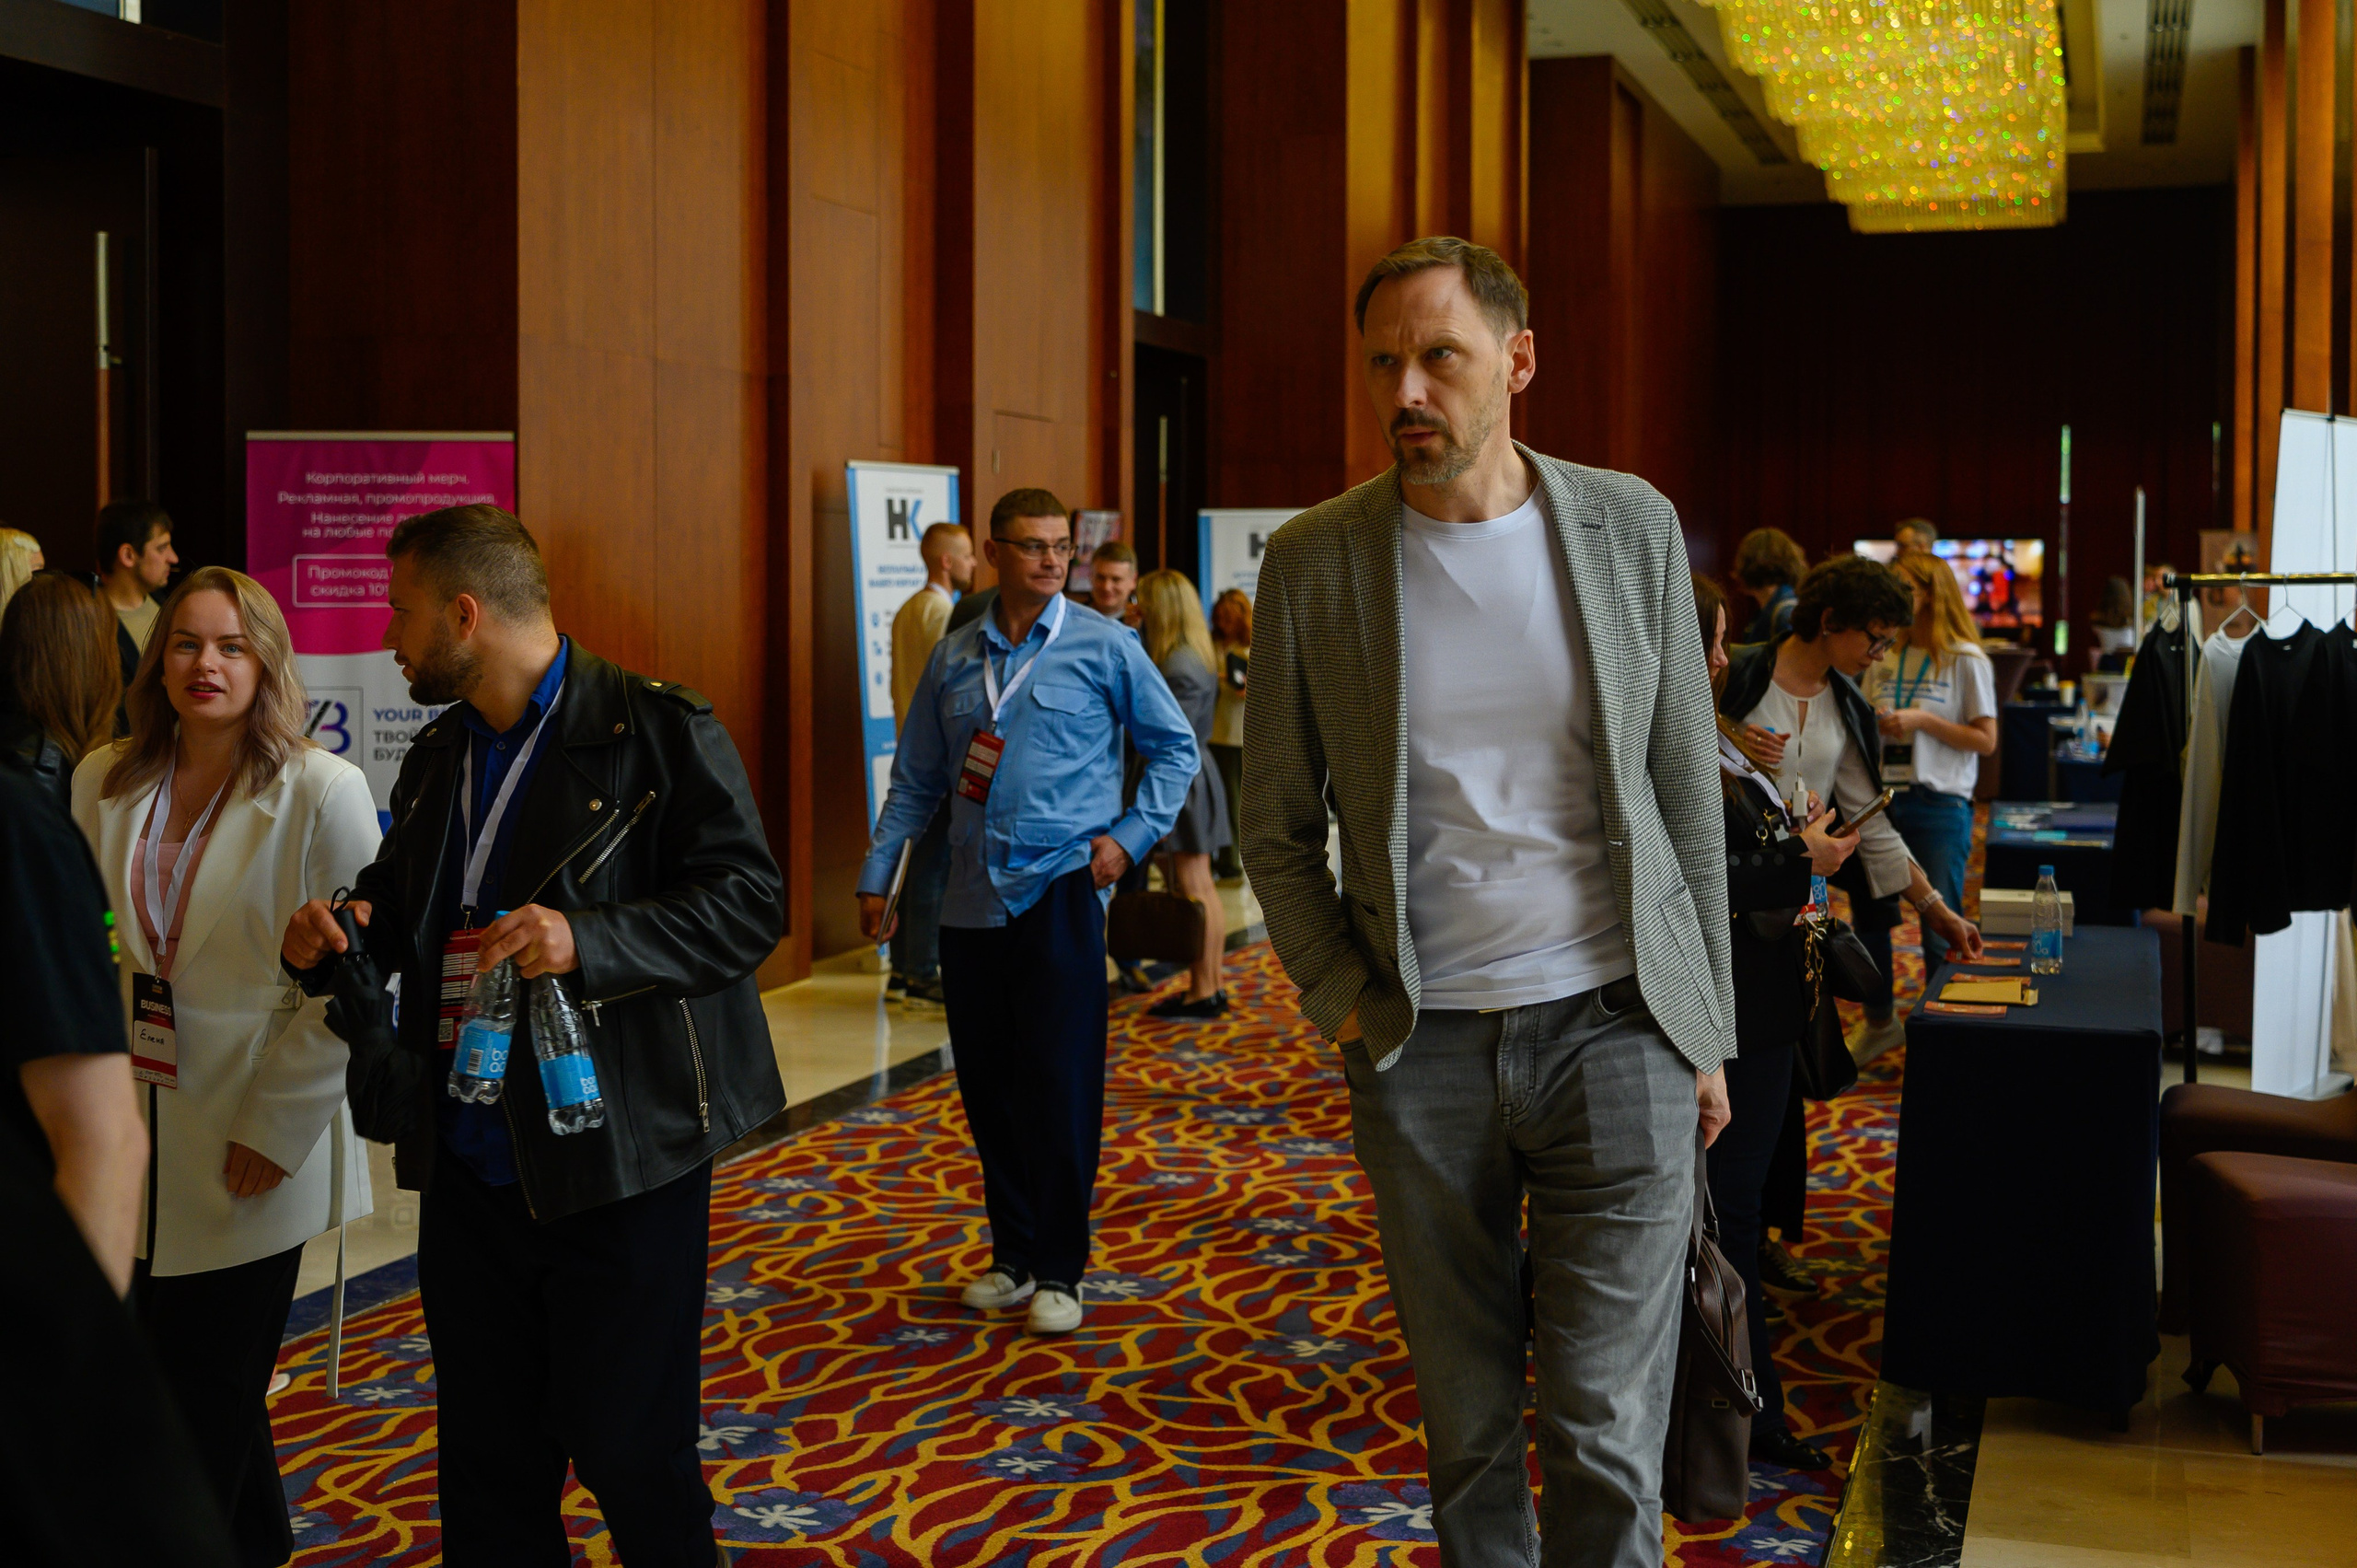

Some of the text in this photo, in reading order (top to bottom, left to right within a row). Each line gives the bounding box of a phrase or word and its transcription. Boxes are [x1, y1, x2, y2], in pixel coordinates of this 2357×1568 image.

[306, 471, 424, 485] Корпоративный
[277, 491, 363, 505] Рекламная,
[310, 511, 393, 524] Нанесение
[302, 528, 320, 538] на
[323, 525, 374, 539] любые
[308, 564, 389, 582] Промокод
[310, 584, 389, 598] скидка 10
[373, 708, 423, 722] YOUR
[140, 999, 172, 1016] BUSINESS
